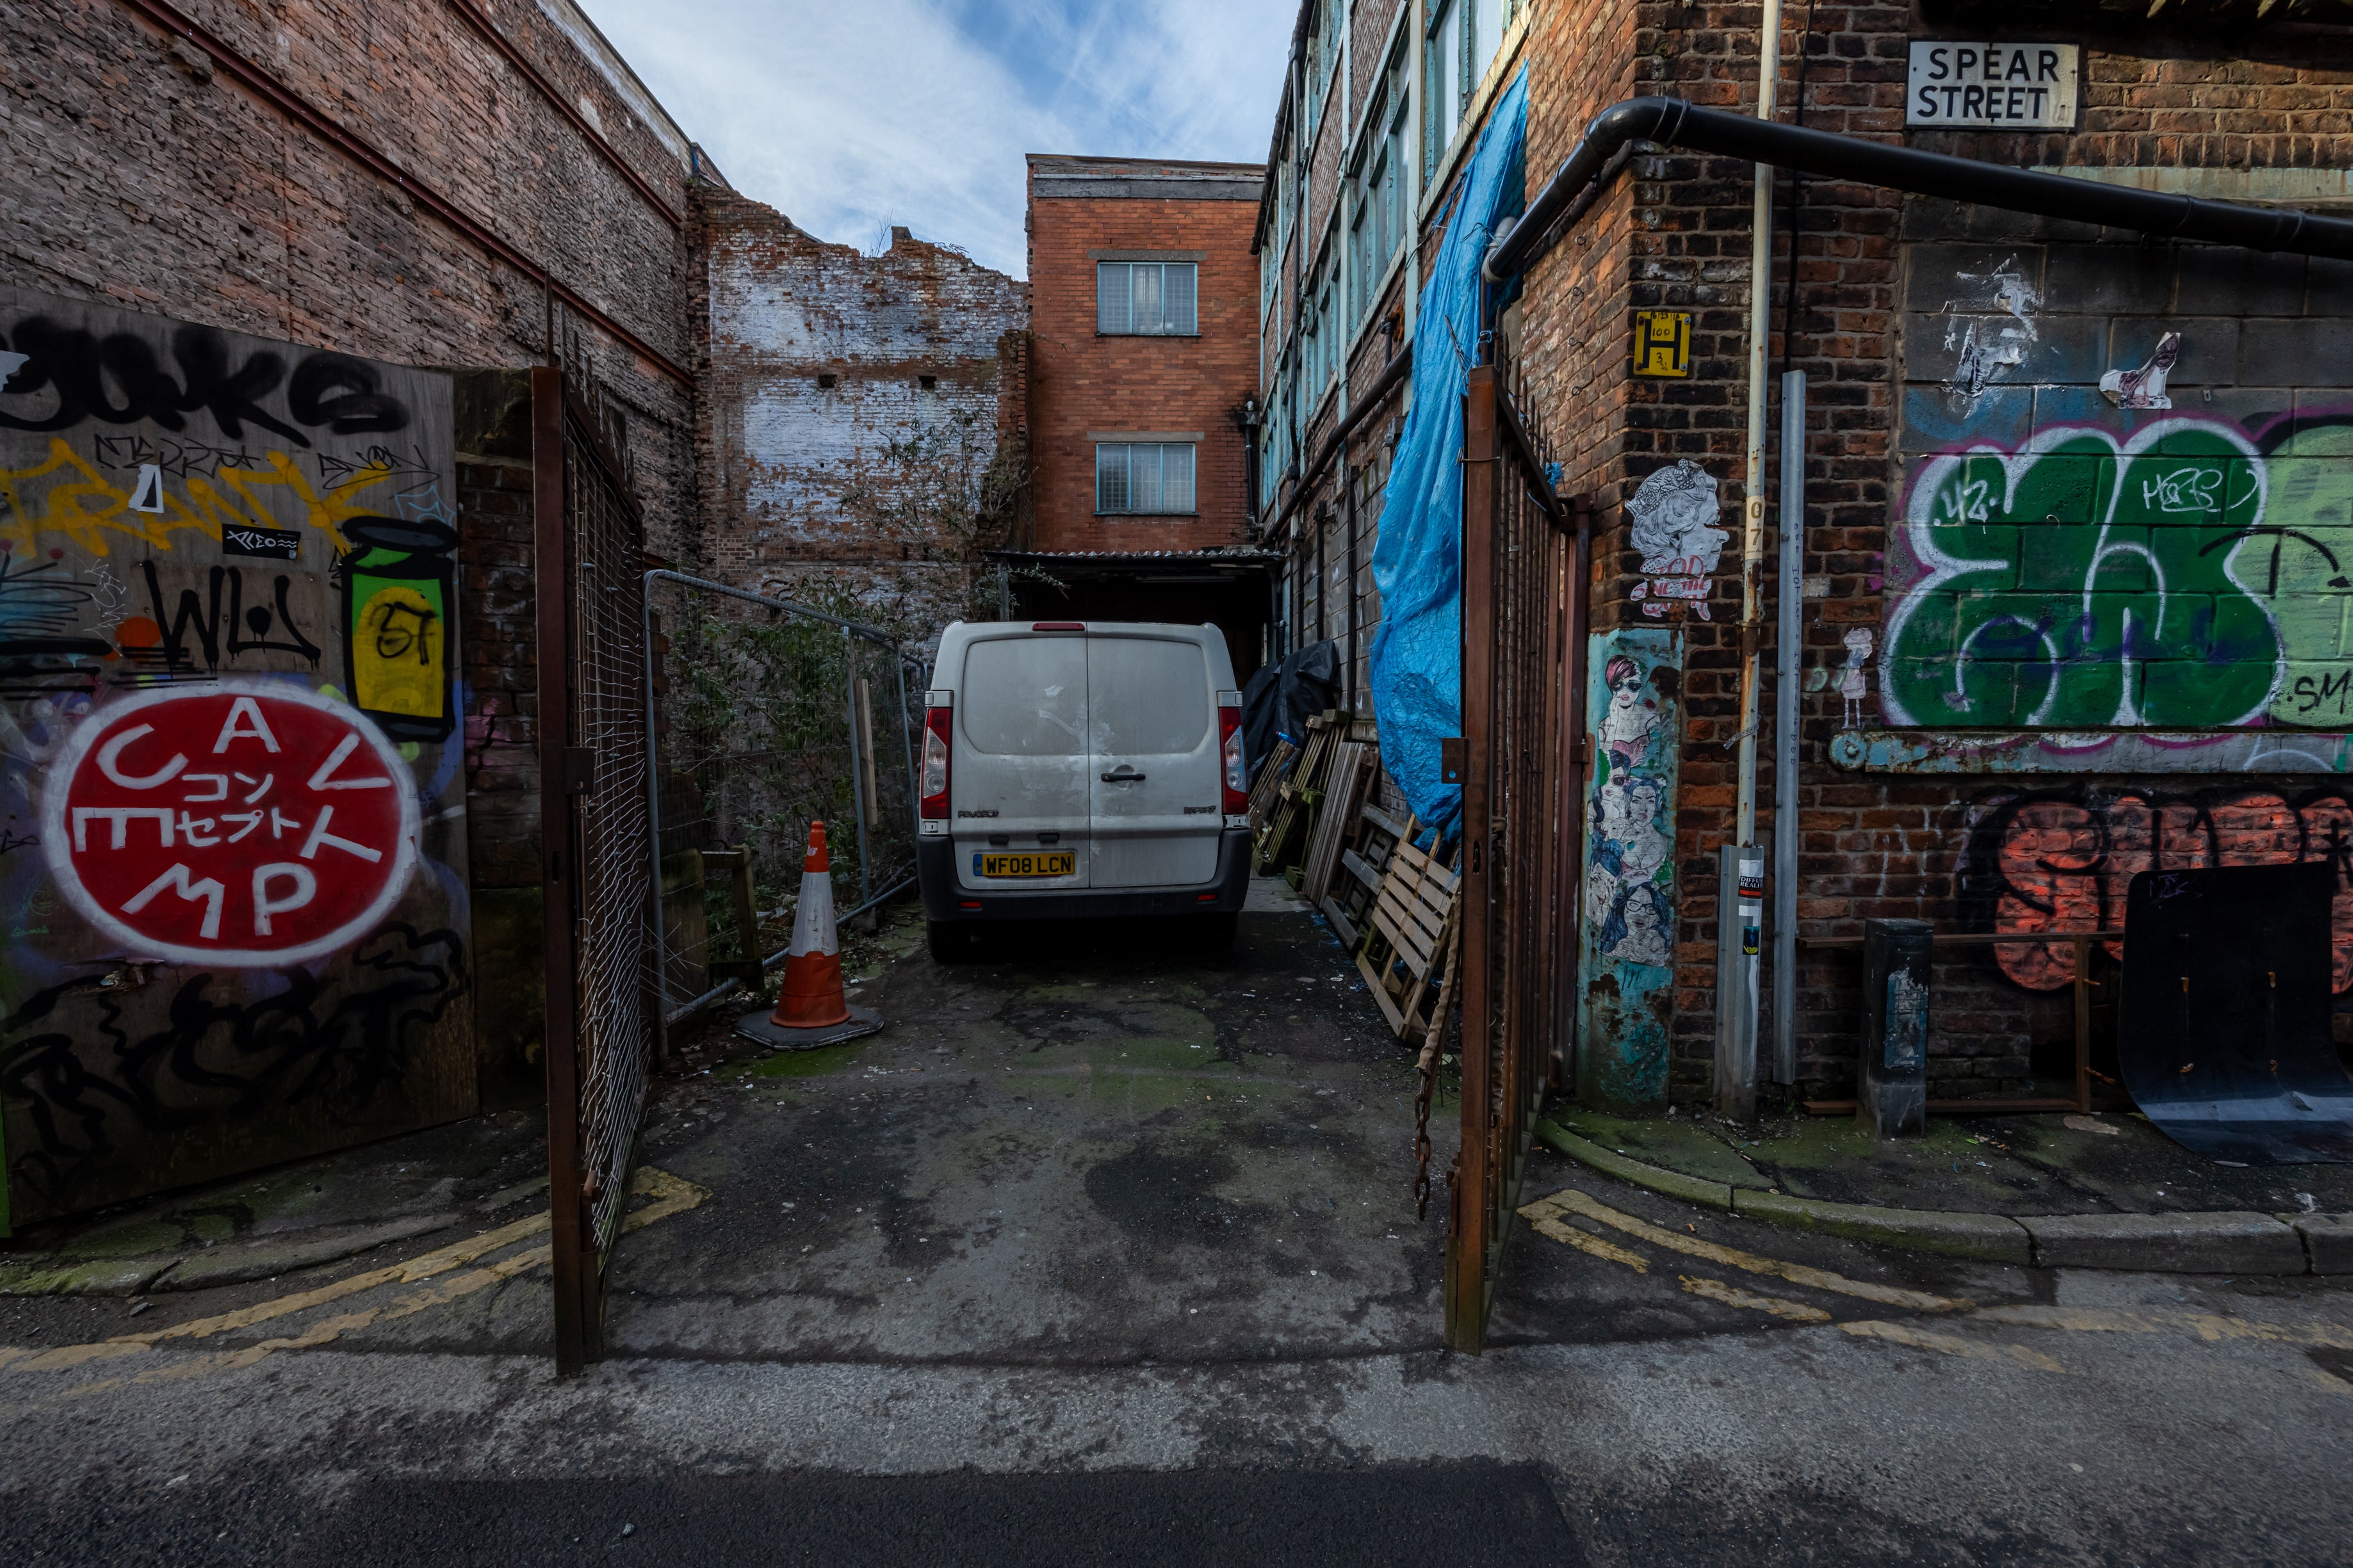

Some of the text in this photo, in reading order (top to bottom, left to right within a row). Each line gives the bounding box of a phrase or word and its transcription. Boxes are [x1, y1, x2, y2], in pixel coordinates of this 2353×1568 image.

[1928, 48, 2060, 82] SPEAR
[1916, 85, 2048, 120] STREET
[1652, 328, 1670, 337] 100
[1643, 319, 1682, 369] H
[957, 810, 999, 818] PEUGEOT
[1184, 805, 1217, 814] EXPERT
[1038, 856, 1071, 873] LCN
